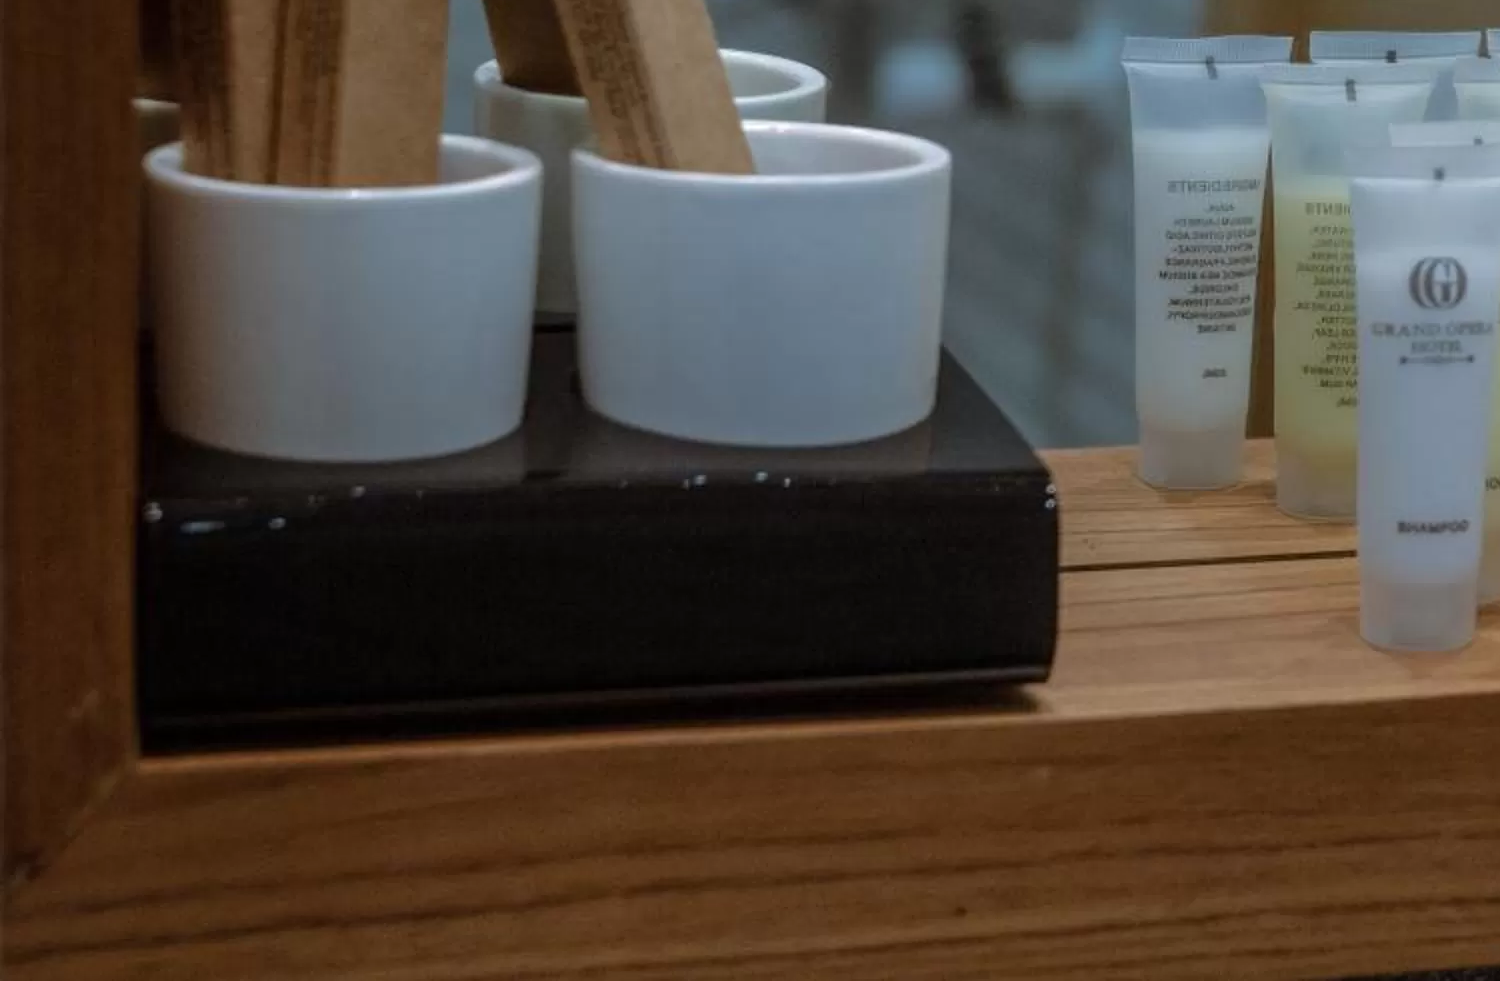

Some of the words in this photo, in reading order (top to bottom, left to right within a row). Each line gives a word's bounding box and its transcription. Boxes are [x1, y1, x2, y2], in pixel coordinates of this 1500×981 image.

[1370, 321, 1442, 338] GRAND
[1411, 339, 1463, 354] HOTEL
[1397, 519, 1469, 534] SHAMPOO
